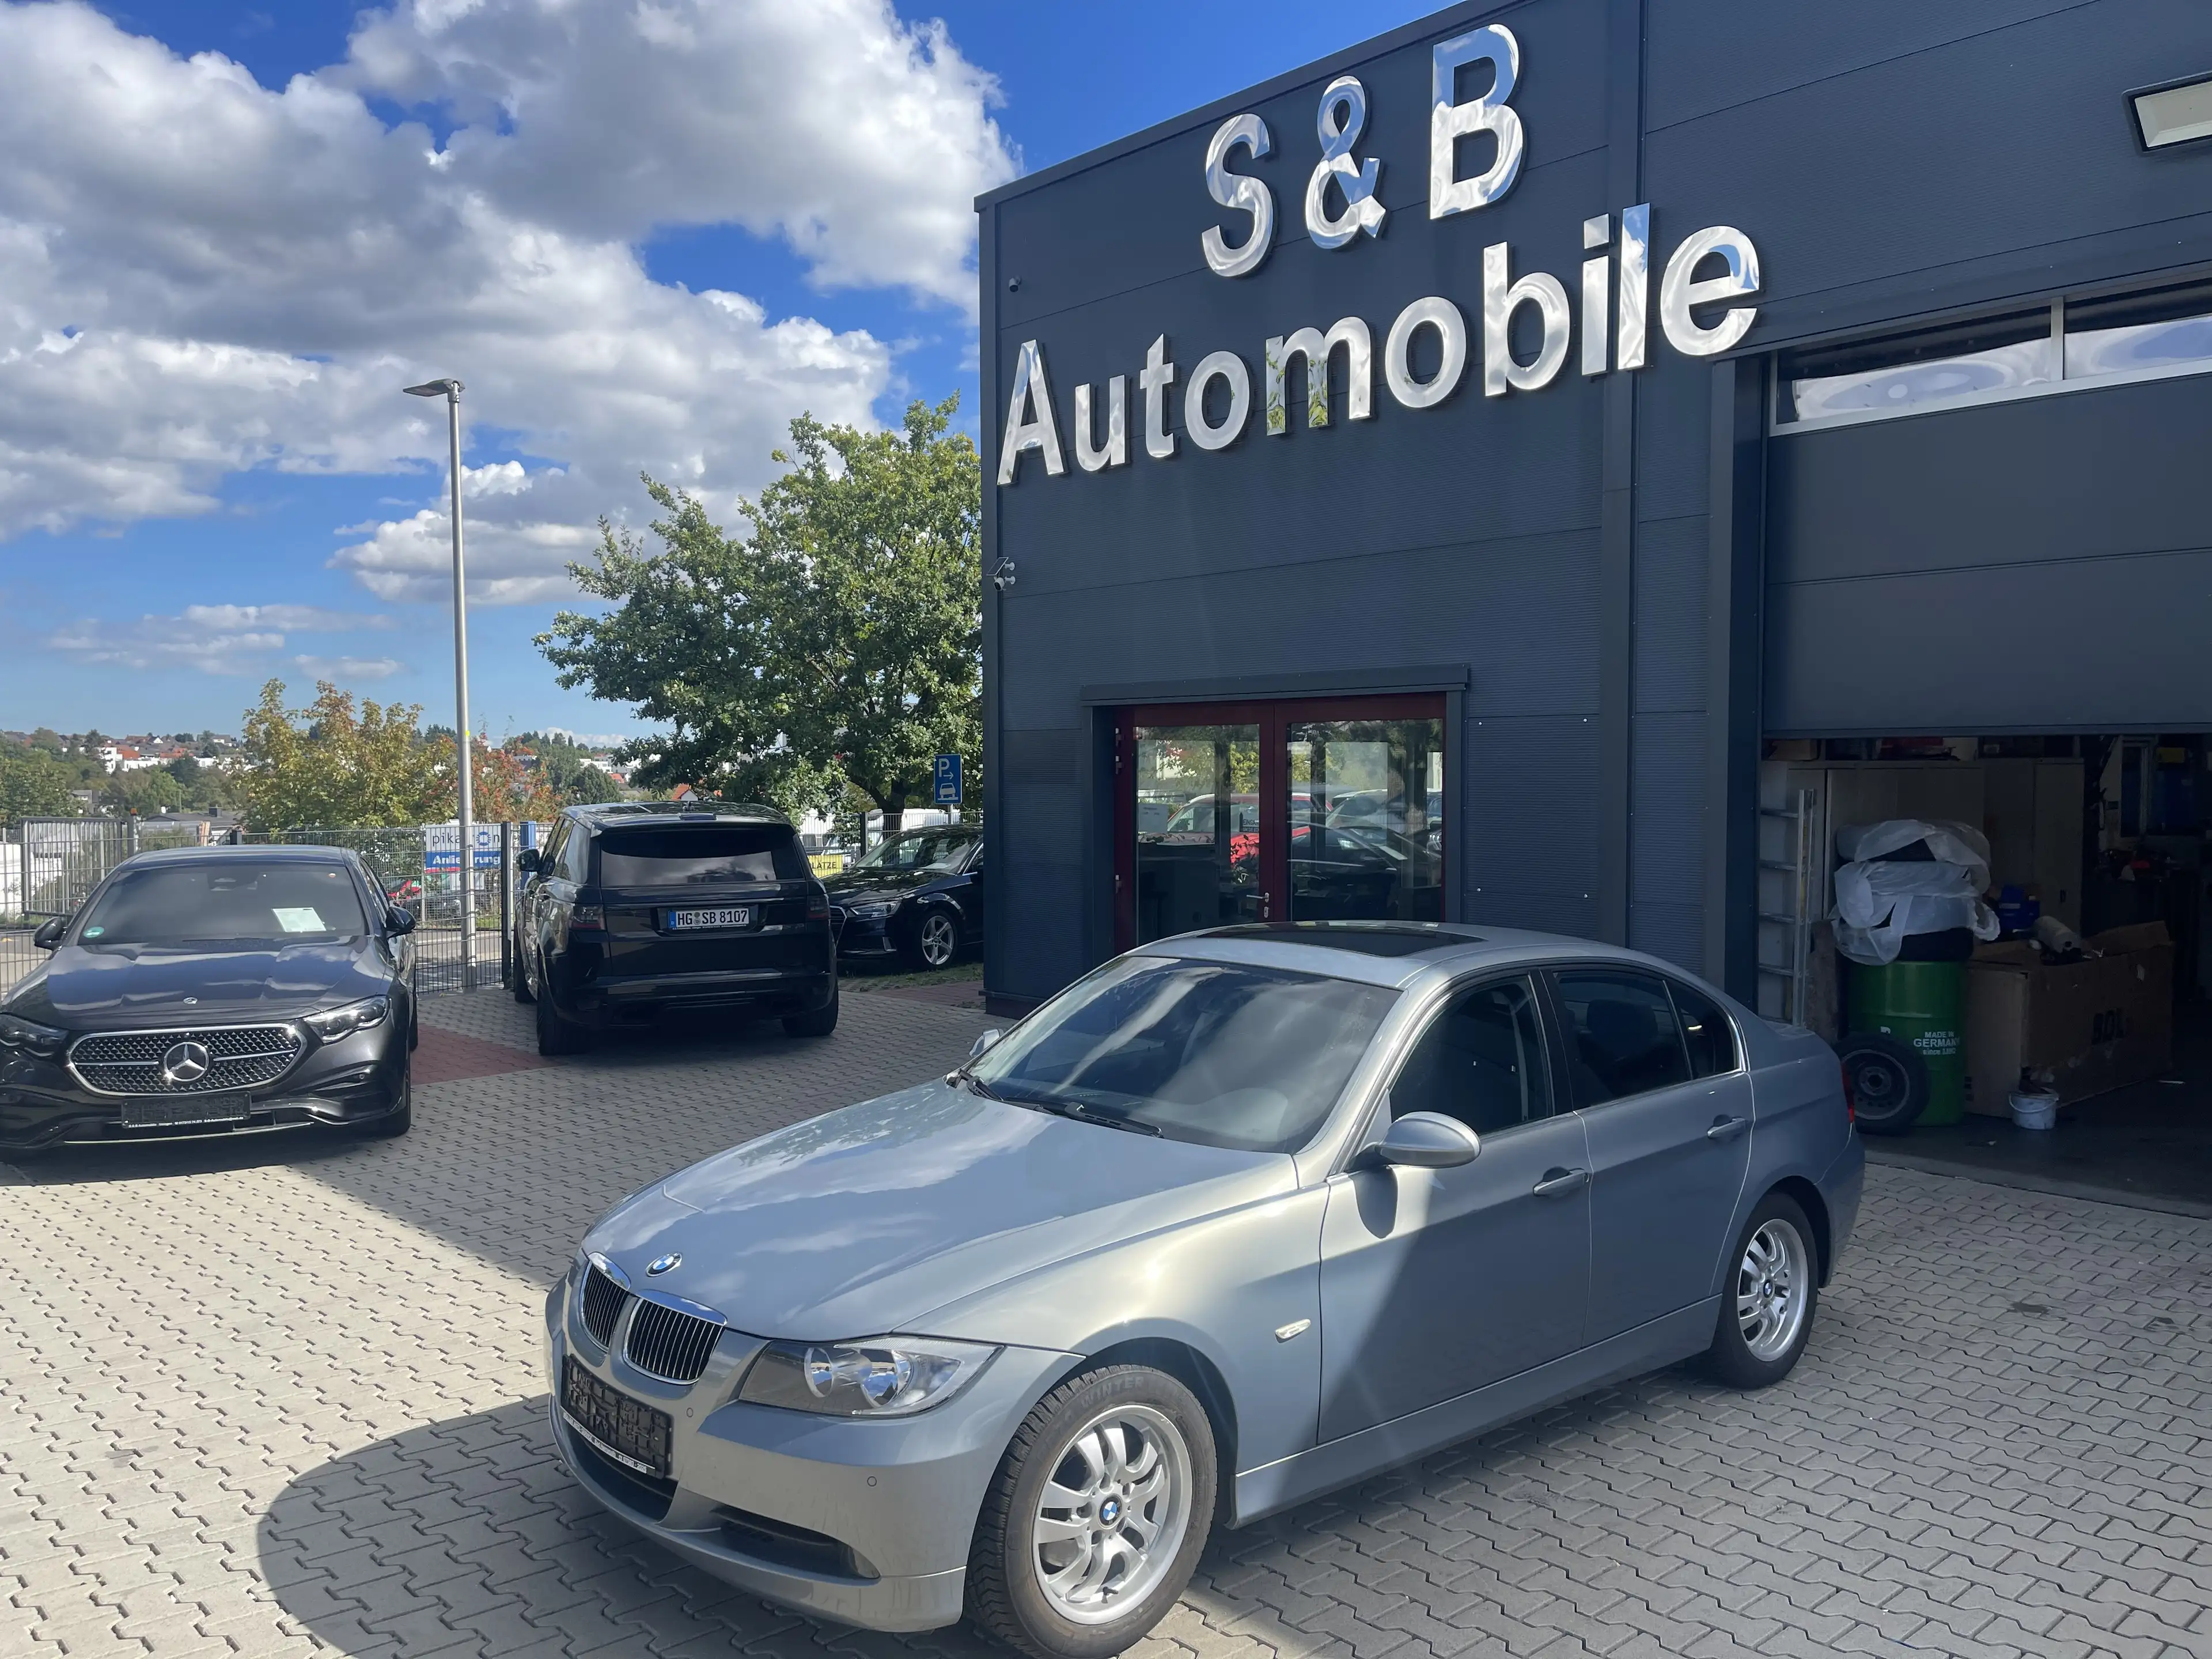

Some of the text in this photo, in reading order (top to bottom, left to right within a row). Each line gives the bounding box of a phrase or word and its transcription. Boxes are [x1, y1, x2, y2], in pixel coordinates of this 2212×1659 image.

[1202, 24, 1523, 276] S & B
[997, 203, 1759, 485] Automobile
[938, 758, 950, 778] P
[433, 855, 500, 865] Anlierung
[810, 860, 836, 869] LÄTZE
[677, 910, 747, 925] HG SB 8107
